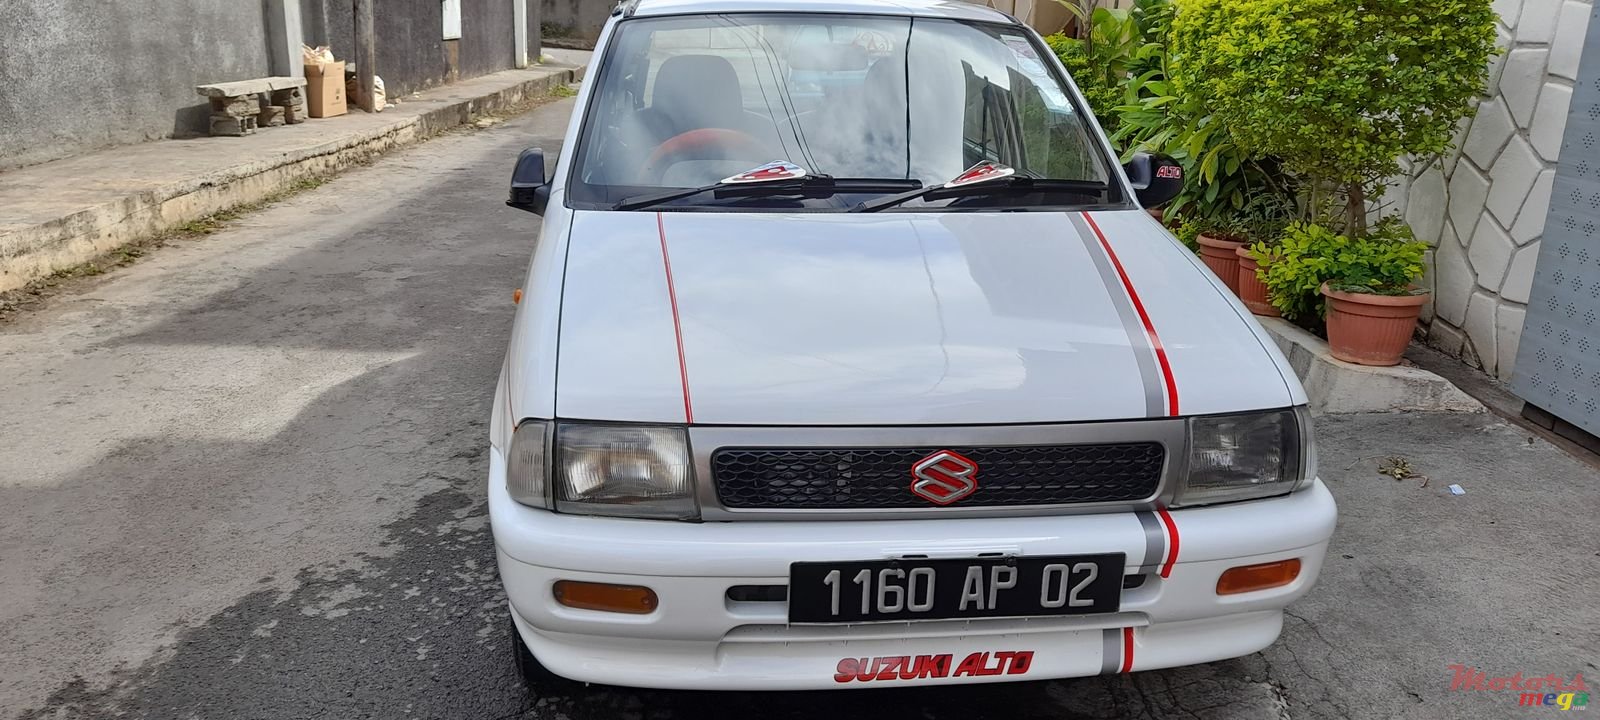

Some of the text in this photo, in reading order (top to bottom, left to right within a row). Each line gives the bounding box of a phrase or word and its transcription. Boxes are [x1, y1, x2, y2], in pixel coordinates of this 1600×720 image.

[1156, 165, 1182, 179] ALTO
[823, 562, 1098, 616] 1160 AP 02
[834, 650, 1035, 683] SUZUKI ALTO
